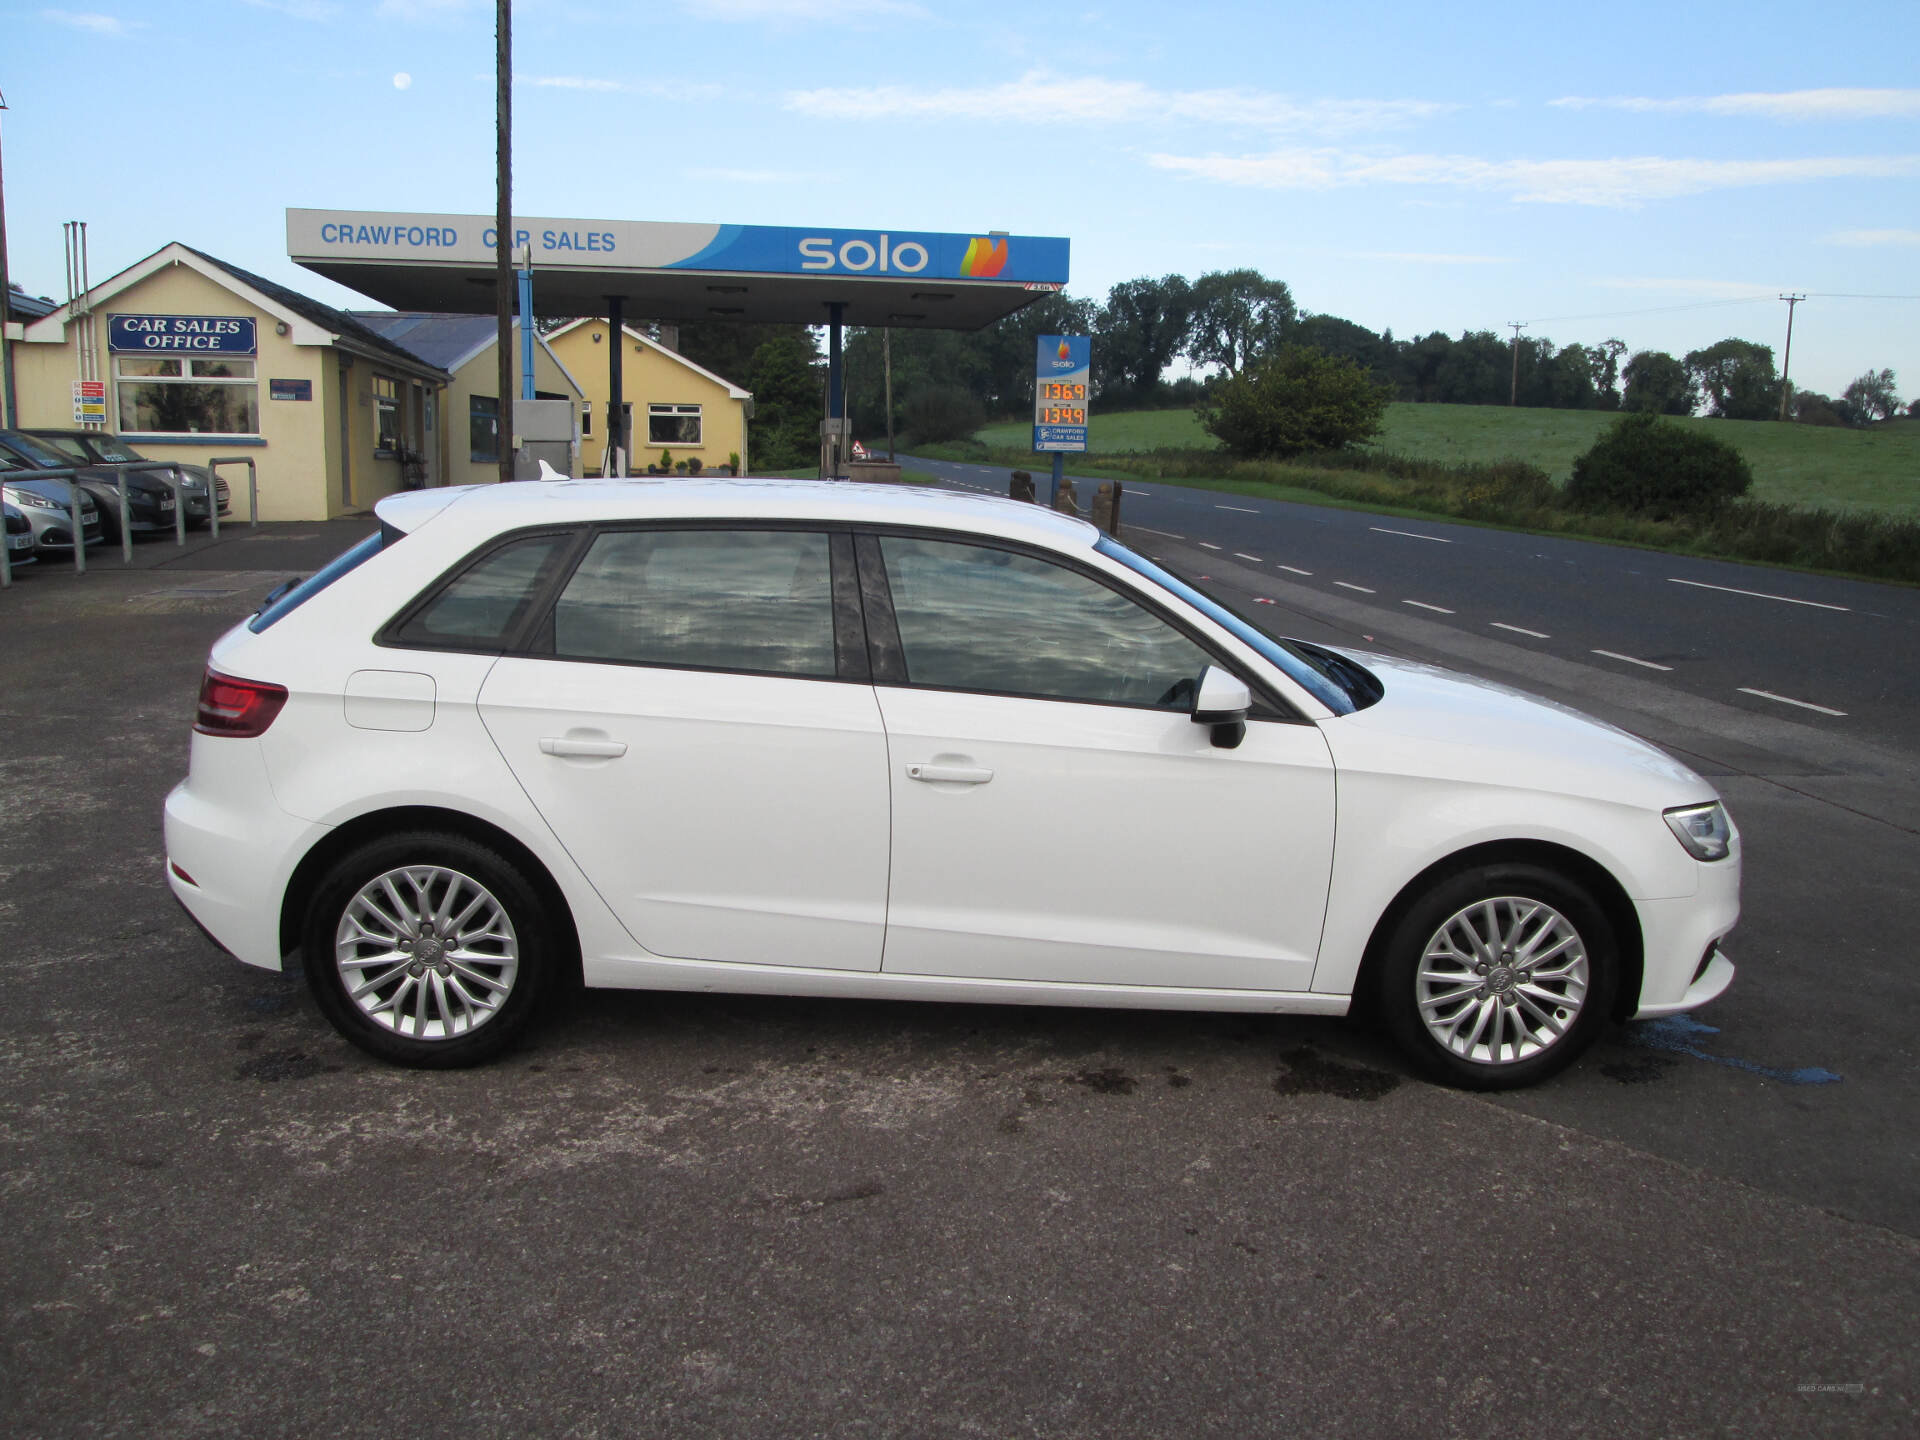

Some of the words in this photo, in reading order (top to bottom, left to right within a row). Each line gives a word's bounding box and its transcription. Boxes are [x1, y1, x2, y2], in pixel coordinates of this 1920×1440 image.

[321, 223, 457, 248] CRAWFORD
[483, 228, 530, 249] CR
[542, 231, 616, 252] SALES
[798, 234, 929, 273] solo
[123, 319, 166, 333] CAR
[174, 320, 240, 334] SALES
[144, 335, 221, 349] OFFICE
[1052, 360, 1075, 368] solo
